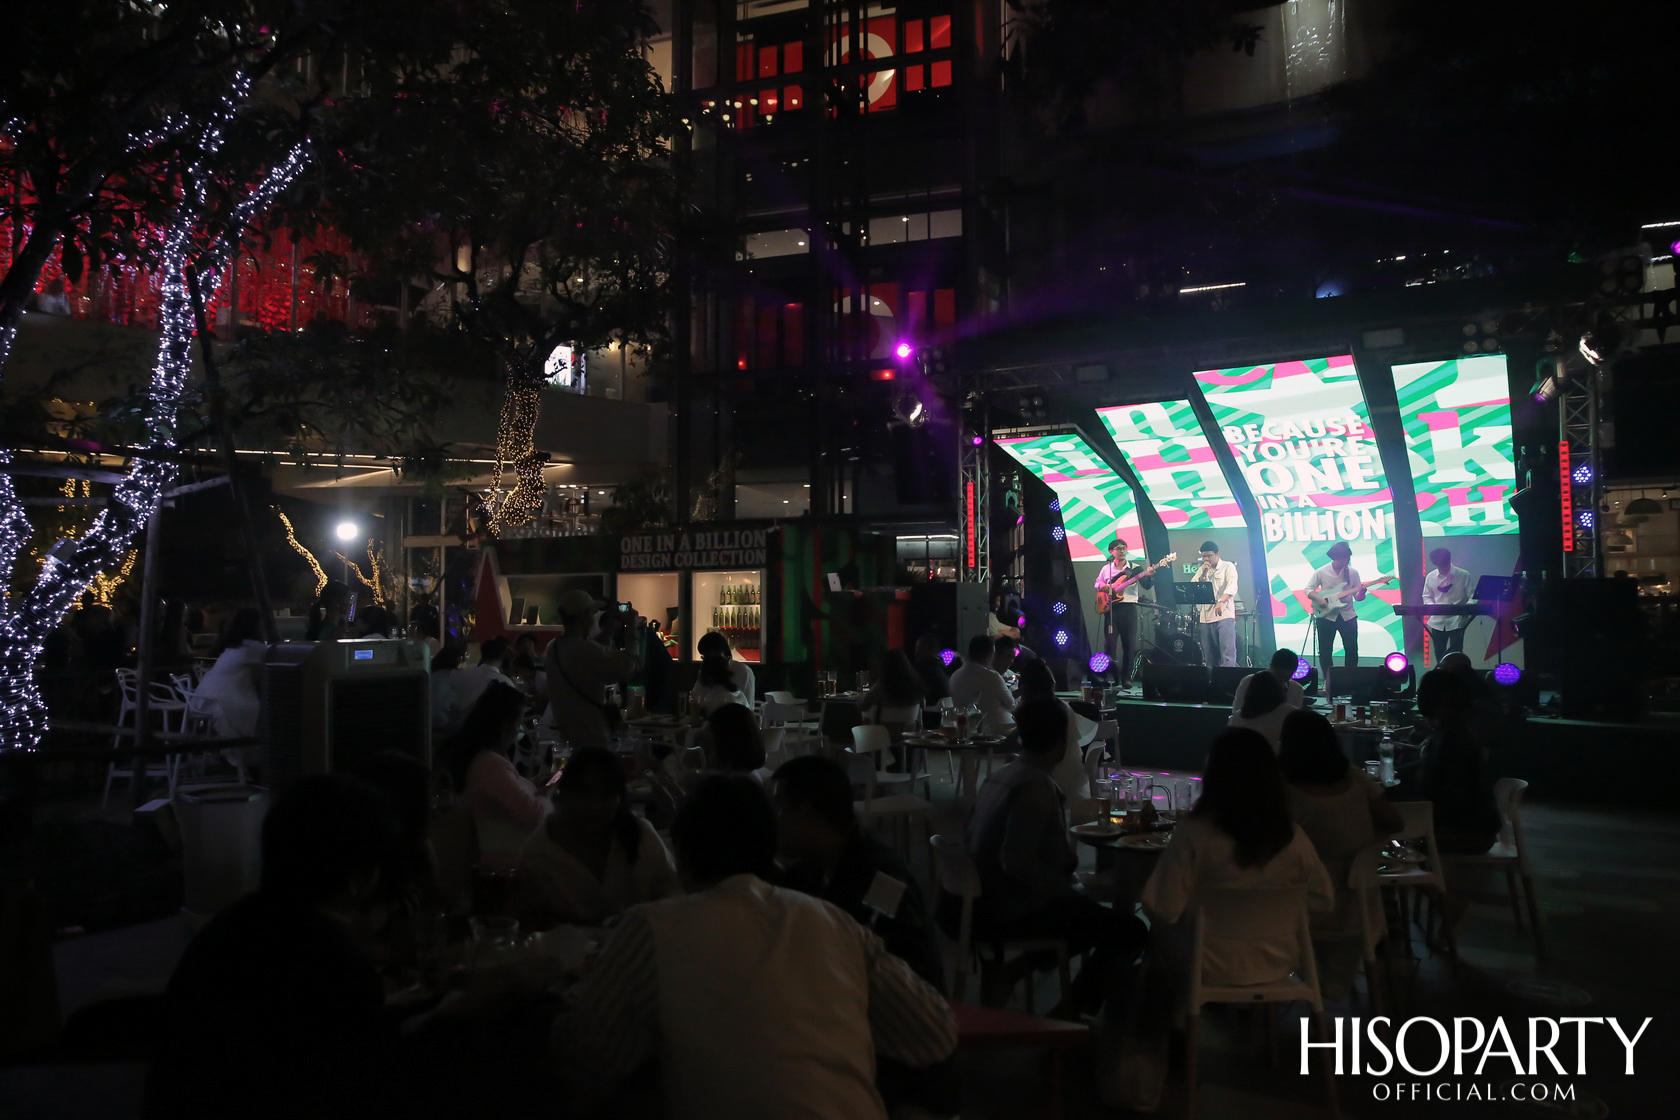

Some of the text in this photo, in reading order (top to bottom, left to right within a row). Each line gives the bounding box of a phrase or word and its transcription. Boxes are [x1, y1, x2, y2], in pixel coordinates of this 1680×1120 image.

[1222, 414, 1365, 444] BECAUSE
[1233, 436, 1368, 463] YOU'RE
[1246, 456, 1380, 494] ONE
[1256, 494, 1318, 510] IN A
[1264, 508, 1386, 542] BILLION
[621, 530, 766, 553] ONE IN A BILLION
[621, 549, 767, 569] DESIGN COLLECTION
